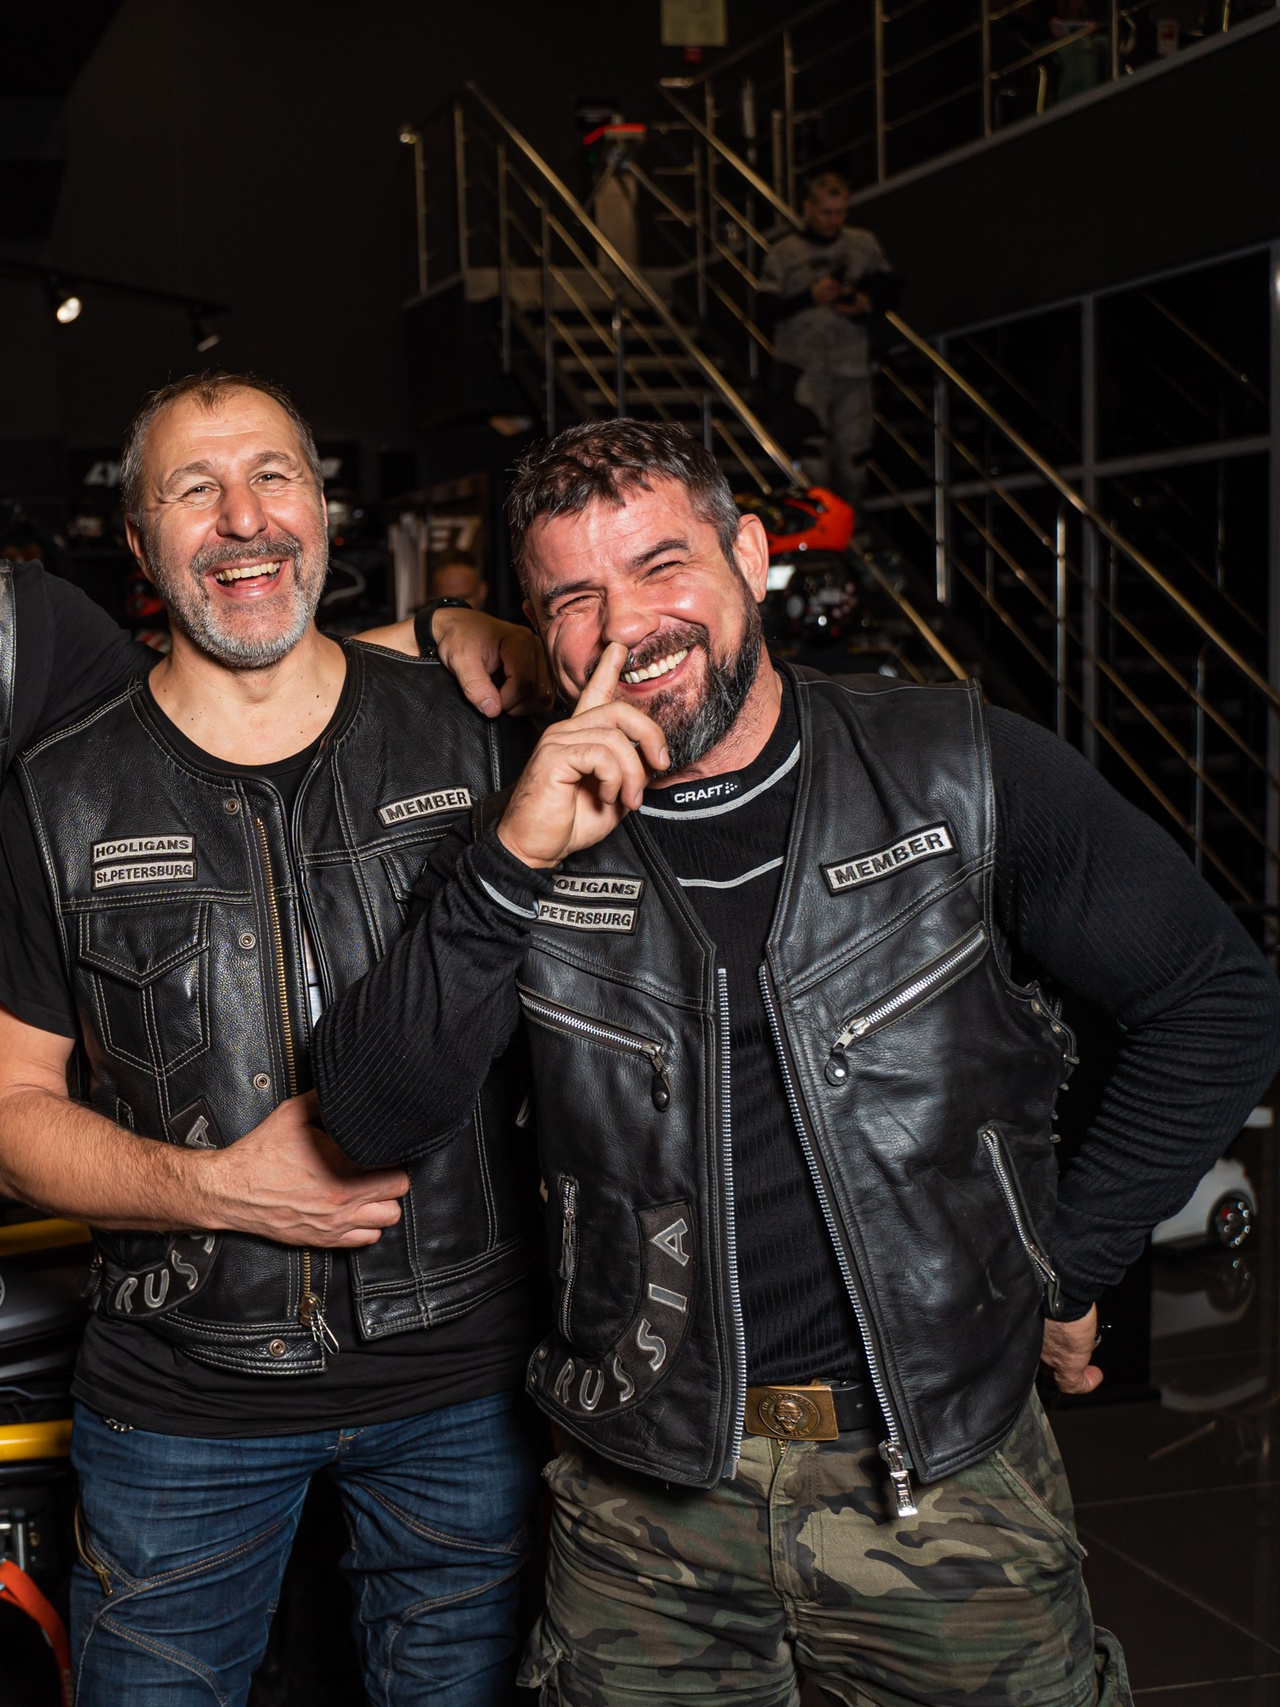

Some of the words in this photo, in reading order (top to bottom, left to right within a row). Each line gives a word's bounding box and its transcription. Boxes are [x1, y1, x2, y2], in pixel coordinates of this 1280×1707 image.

[674, 784, 723, 803] CRAFT
[386, 791, 468, 821] MEMBER
[96, 839, 190, 858] HOOLIGANS
[834, 832, 944, 885] MEMBER
[555, 879, 637, 895] OLIGANS
[540, 904, 631, 927] PETERSBURG
[554, 1218, 689, 1410] RUSSIA
